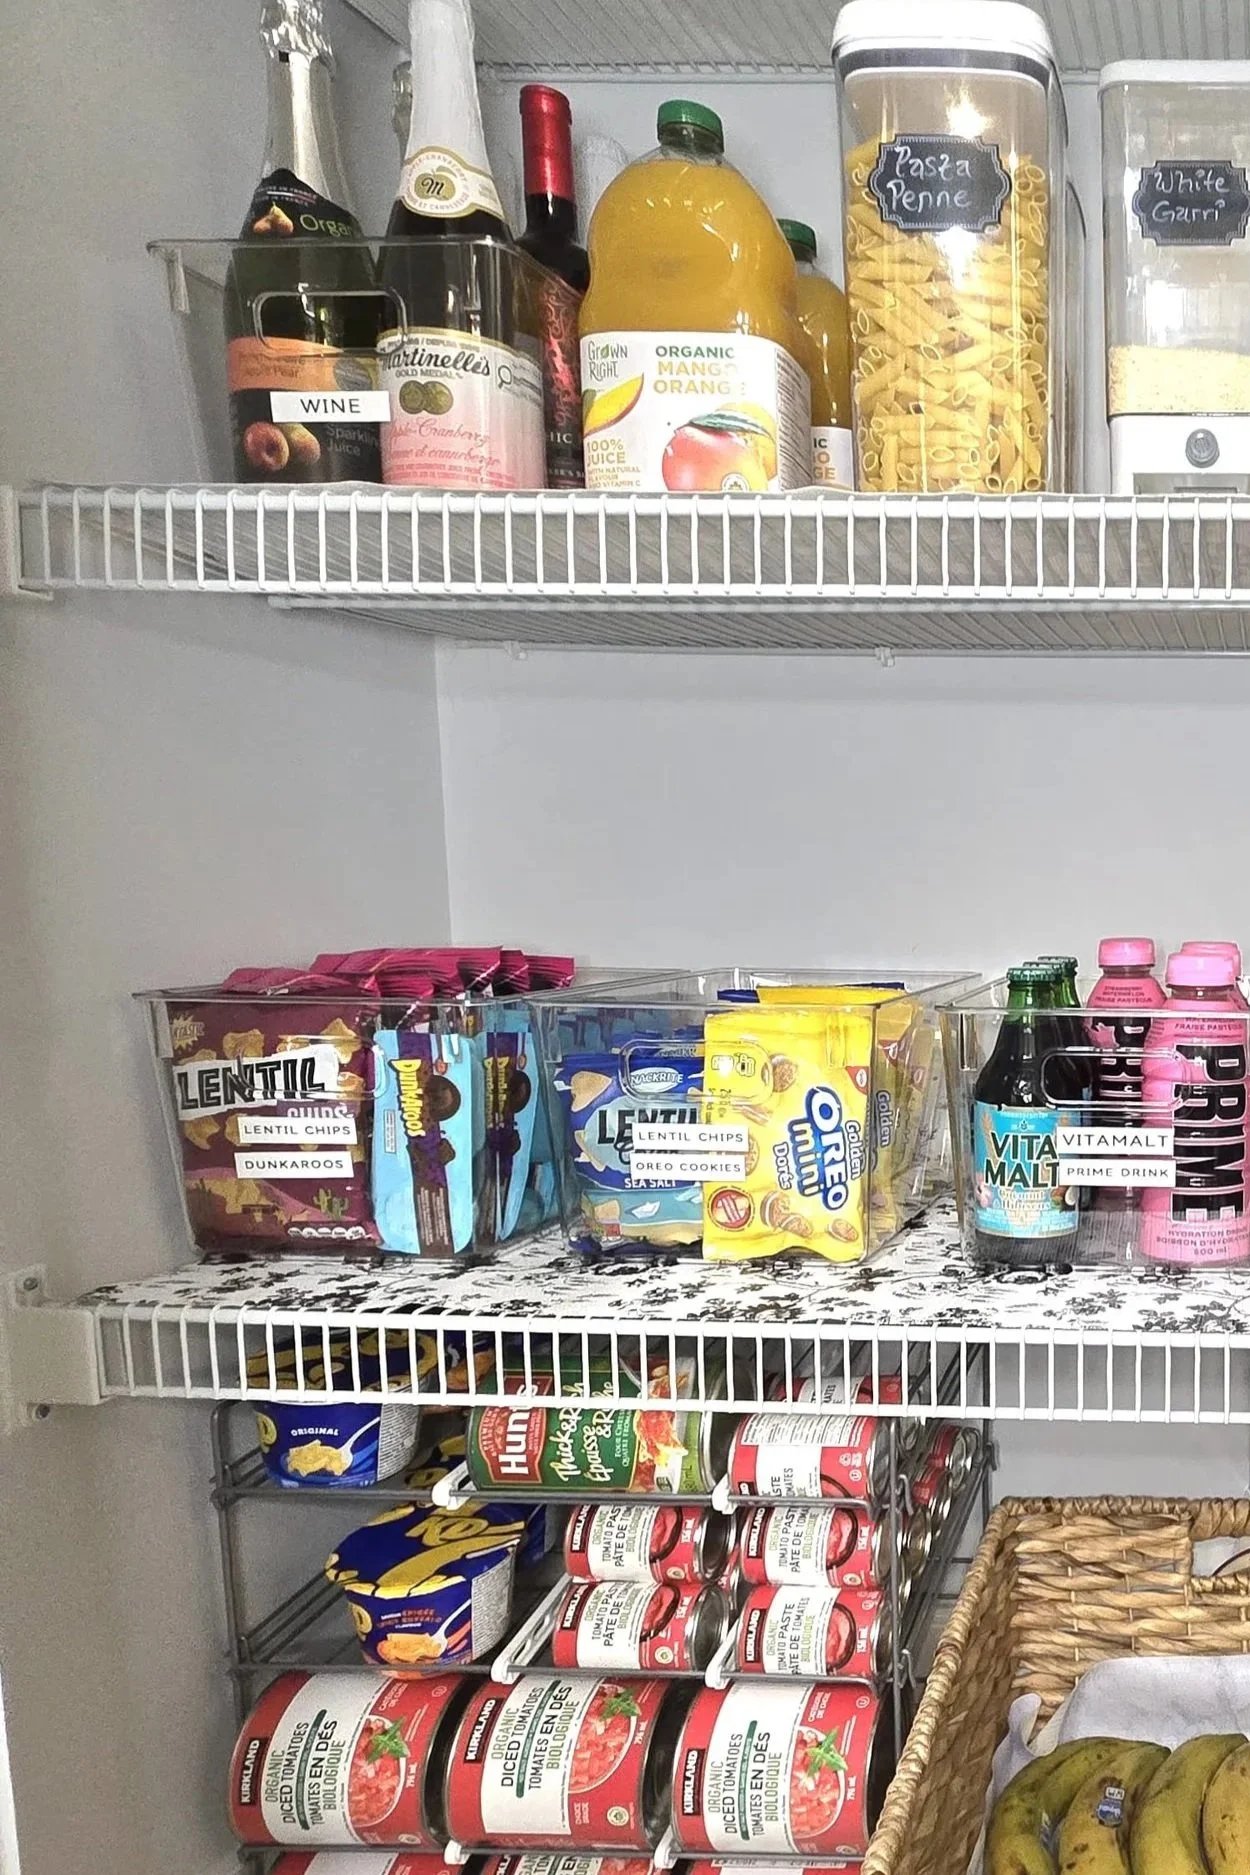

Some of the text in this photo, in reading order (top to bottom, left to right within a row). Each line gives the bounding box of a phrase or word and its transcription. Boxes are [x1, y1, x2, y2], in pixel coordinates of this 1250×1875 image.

[894, 145, 973, 181] Pasta
[1153, 168, 1230, 194] White
[886, 178, 970, 214] Penne
[300, 214, 352, 238] Orga
[655, 345, 736, 359] ORGANIC
[300, 398, 361, 414] WINE
[326, 423, 379, 446] Sparklin
[327, 440, 361, 456] Juice
[587, 439, 624, 451] 100%
[587, 452, 626, 465] JUICE
[175, 1056, 326, 1111] LENTIL
[629, 1070, 684, 1087] NACKRITE
[244, 1125, 352, 1136] LENTIL CHIPS
[638, 1131, 744, 1143] LENTIL CHIPS
[876, 1090, 891, 1147] Golden
[1171, 1044, 1246, 1223] PRIME
[792, 1121, 822, 1197] mini
[808, 1087, 849, 1209] OREO
[845, 1120, 863, 1180] Golden
[990, 1131, 1058, 1161] VITA
[1062, 1133, 1169, 1148] VITAMALT
[245, 1159, 344, 1170] DUNKAROOS
[624, 1177, 648, 1189] SEA
[635, 1162, 741, 1172] OREO COOKIES
[984, 1158, 1060, 1188] MALT
[1067, 1167, 1169, 1177] PRIME DRINK
[290, 1427, 339, 1437] ORIGINAL
[602, 1506, 621, 1562] TOMATO PAS
[616, 1525, 628, 1541] DE
[778, 1536, 790, 1567] TOMATO
[790, 1531, 802, 1573] PÂTE DE
[591, 1603, 608, 1641] TOMATO
[603, 1600, 623, 1647] PÂTE DE
[779, 1603, 795, 1639] PASTE
[790, 1634, 801, 1650] DE
[465, 1699, 497, 1761] KIRKLAND
[491, 1706, 519, 1760] ORGANIC
[500, 1686, 545, 1787] DICED TOMATOES
[528, 1685, 573, 1791] TOMATES EN DÉS
[546, 1700, 581, 1770] BIOLOGIQUE
[240, 1739, 260, 1804] KIRKLAND
[264, 1749, 286, 1802] ORGANIC
[279, 1720, 310, 1824] DICED TOMATOES
[307, 1719, 338, 1827] TOMATES EN DÉS
[323, 1739, 346, 1811] BIOLOGIQUE
[683, 1750, 699, 1815] KIRKLAND
[708, 1760, 724, 1813] ORGANIC
[722, 1732, 743, 1834] DICED TOMATOES
[750, 1732, 771, 1837] TOMATES EN DÉS
[764, 1752, 782, 1823] BIOLOGIQUE
